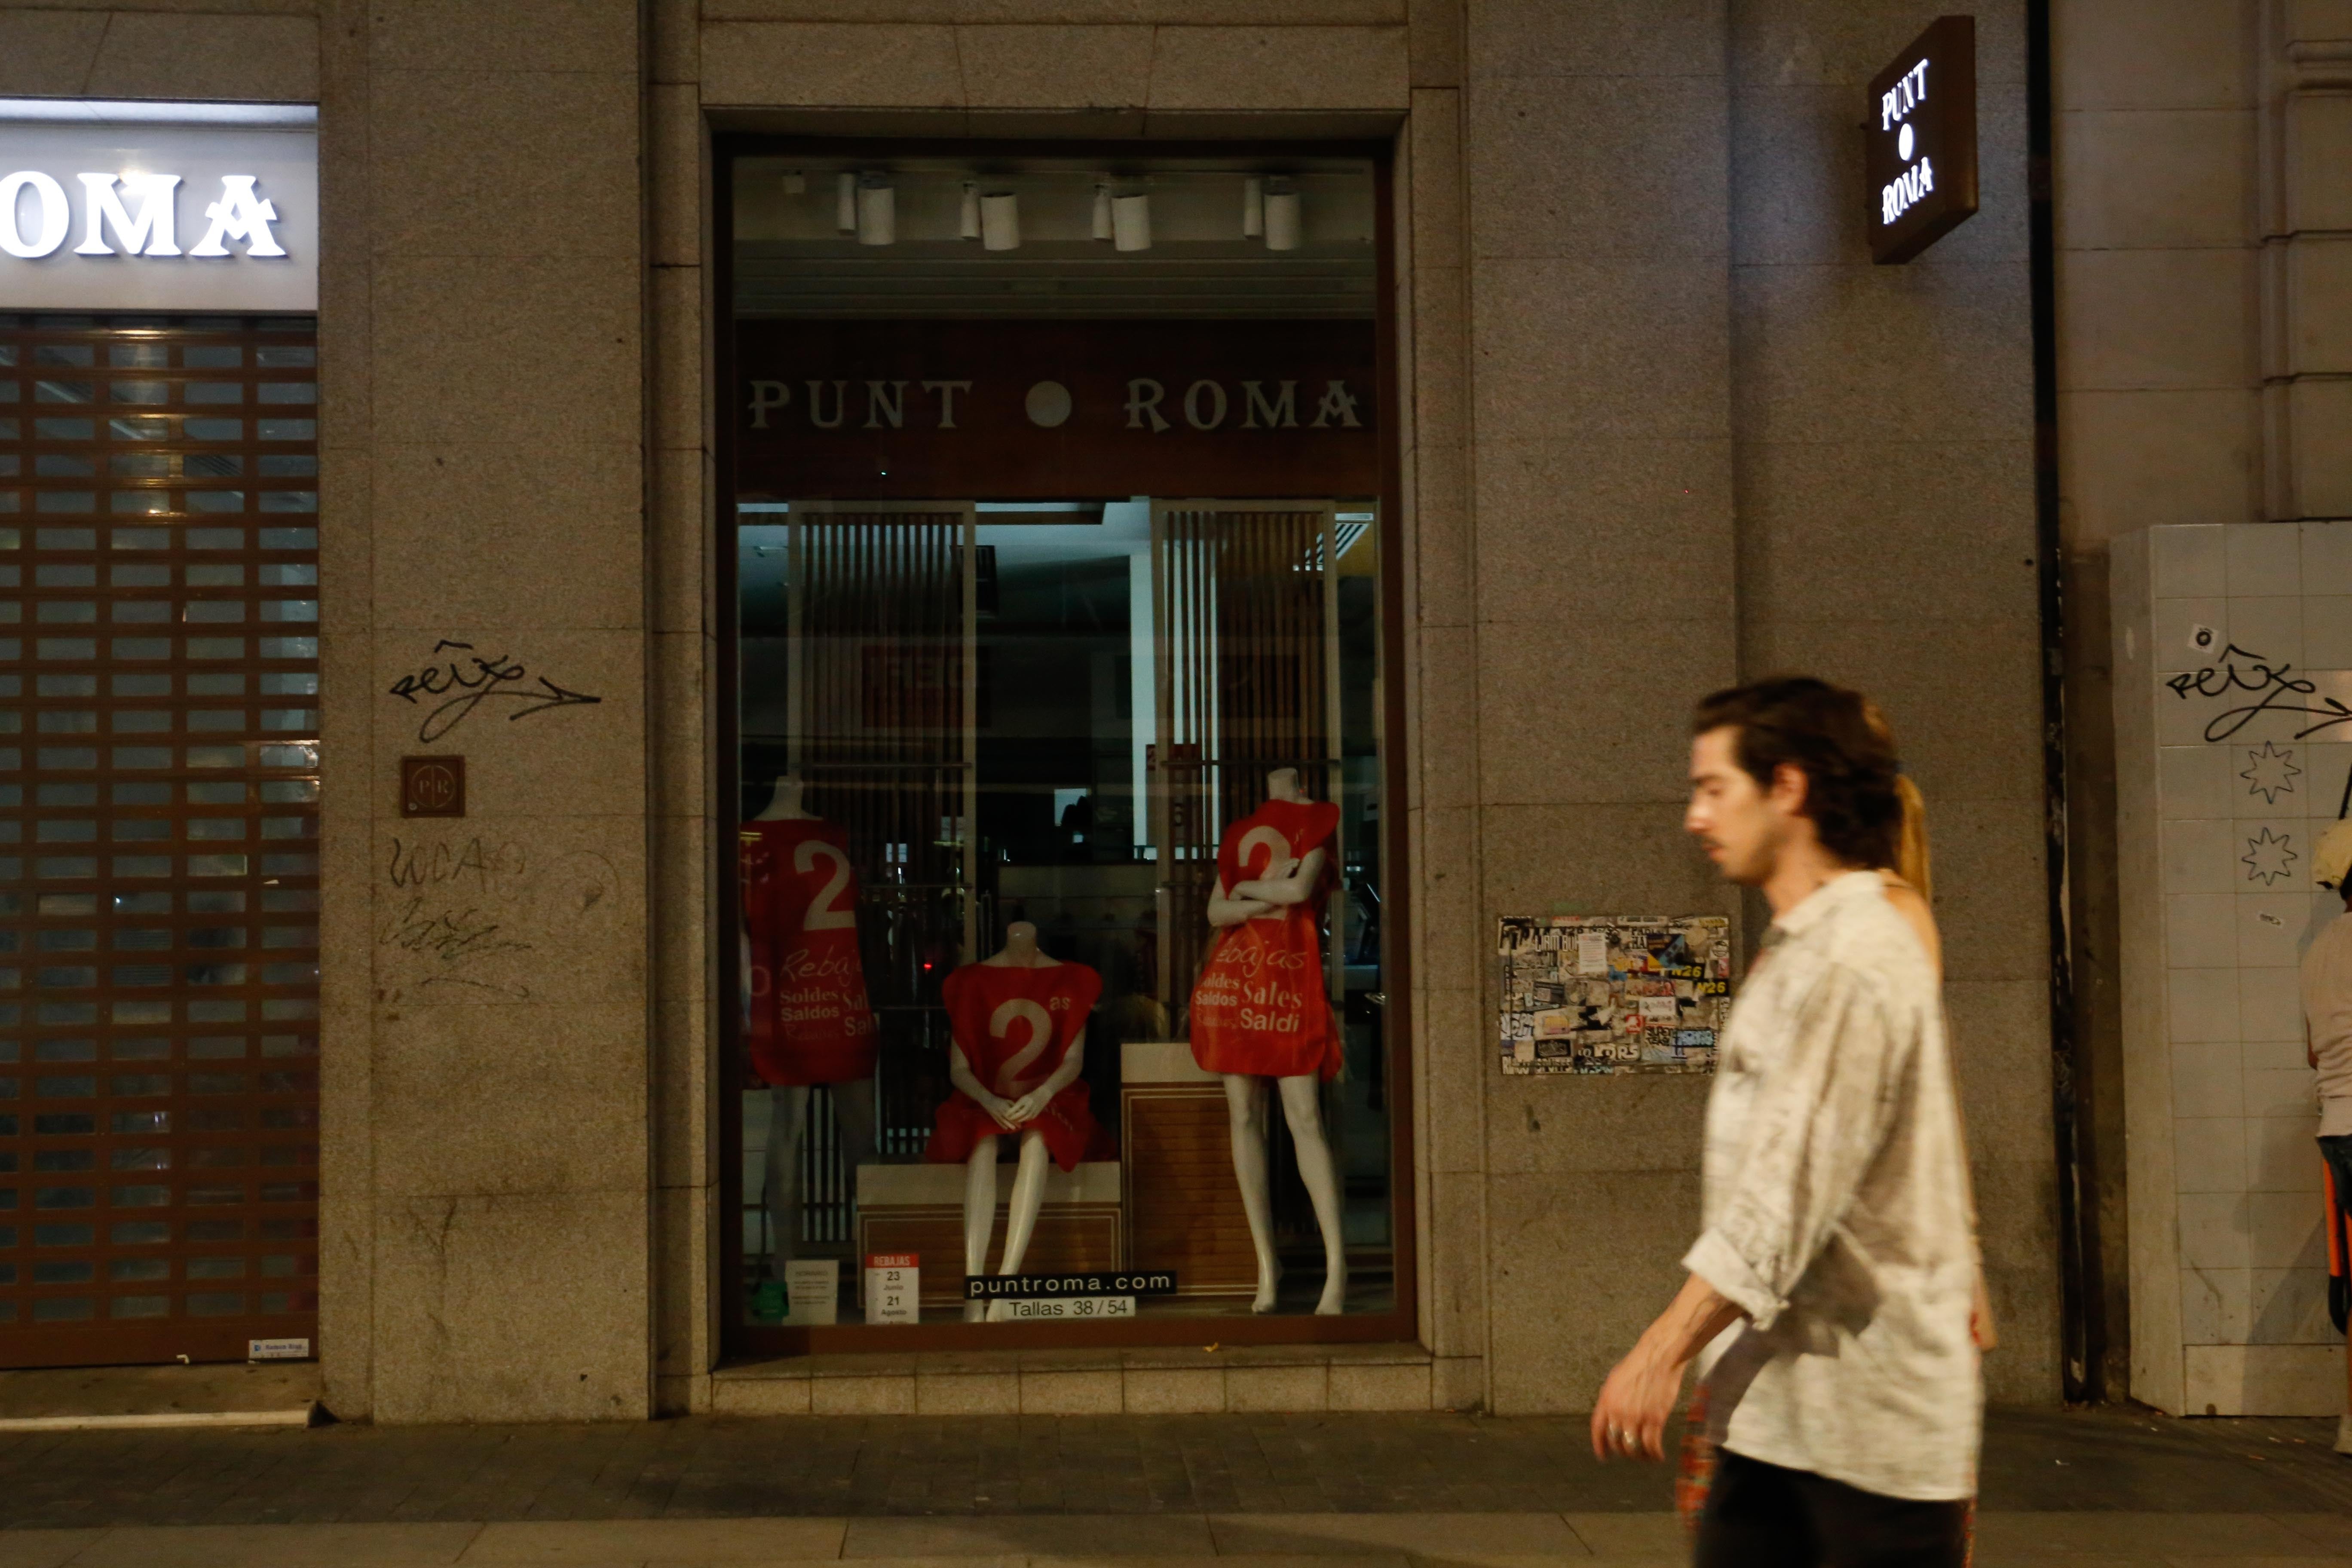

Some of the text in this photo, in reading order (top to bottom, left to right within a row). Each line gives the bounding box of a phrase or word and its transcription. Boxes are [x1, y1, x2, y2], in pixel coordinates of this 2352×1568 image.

[1882, 58, 1929, 131] PUNT
[1882, 156, 1933, 225] ROMA
[0, 171, 287, 258] OMA
[748, 378, 1363, 433] PUNT ROMA
[794, 840, 856, 931] 2
[780, 987, 839, 1004] Soldes
[1243, 980, 1303, 1009] Sales
[781, 1006, 840, 1022] Saldos
[1240, 1008, 1300, 1032] Saldi
[990, 996, 1071, 1099] 2 as
[873, 1255, 910, 1266] REBAJAS
[887, 1271, 900, 1280] 23
[971, 1274, 1170, 1297] puntroma.com
[887, 1296, 899, 1305] 21
[1009, 1301, 1064, 1317] Tallas
